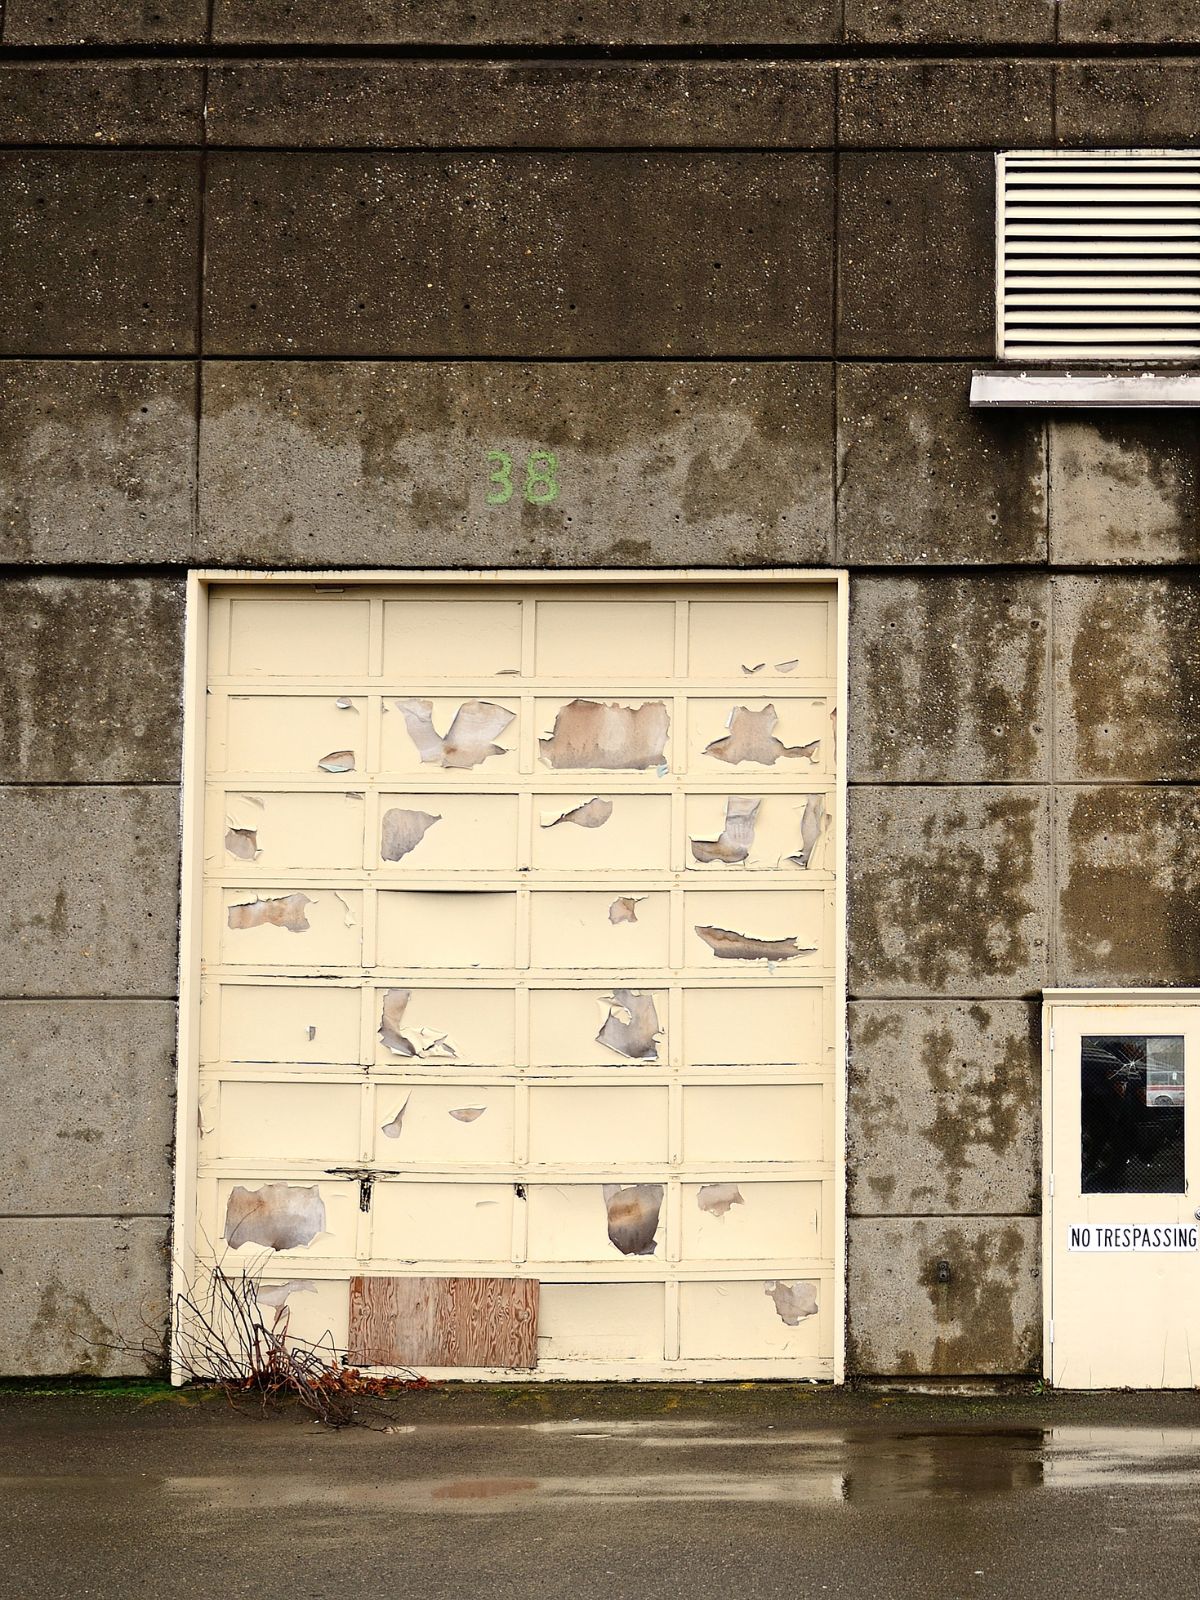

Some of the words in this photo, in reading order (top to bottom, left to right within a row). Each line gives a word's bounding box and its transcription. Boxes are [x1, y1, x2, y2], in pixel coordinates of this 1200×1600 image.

[486, 449, 559, 504] 38
[1071, 1228, 1091, 1248] NO
[1096, 1228, 1198, 1248] TRESPASSING
